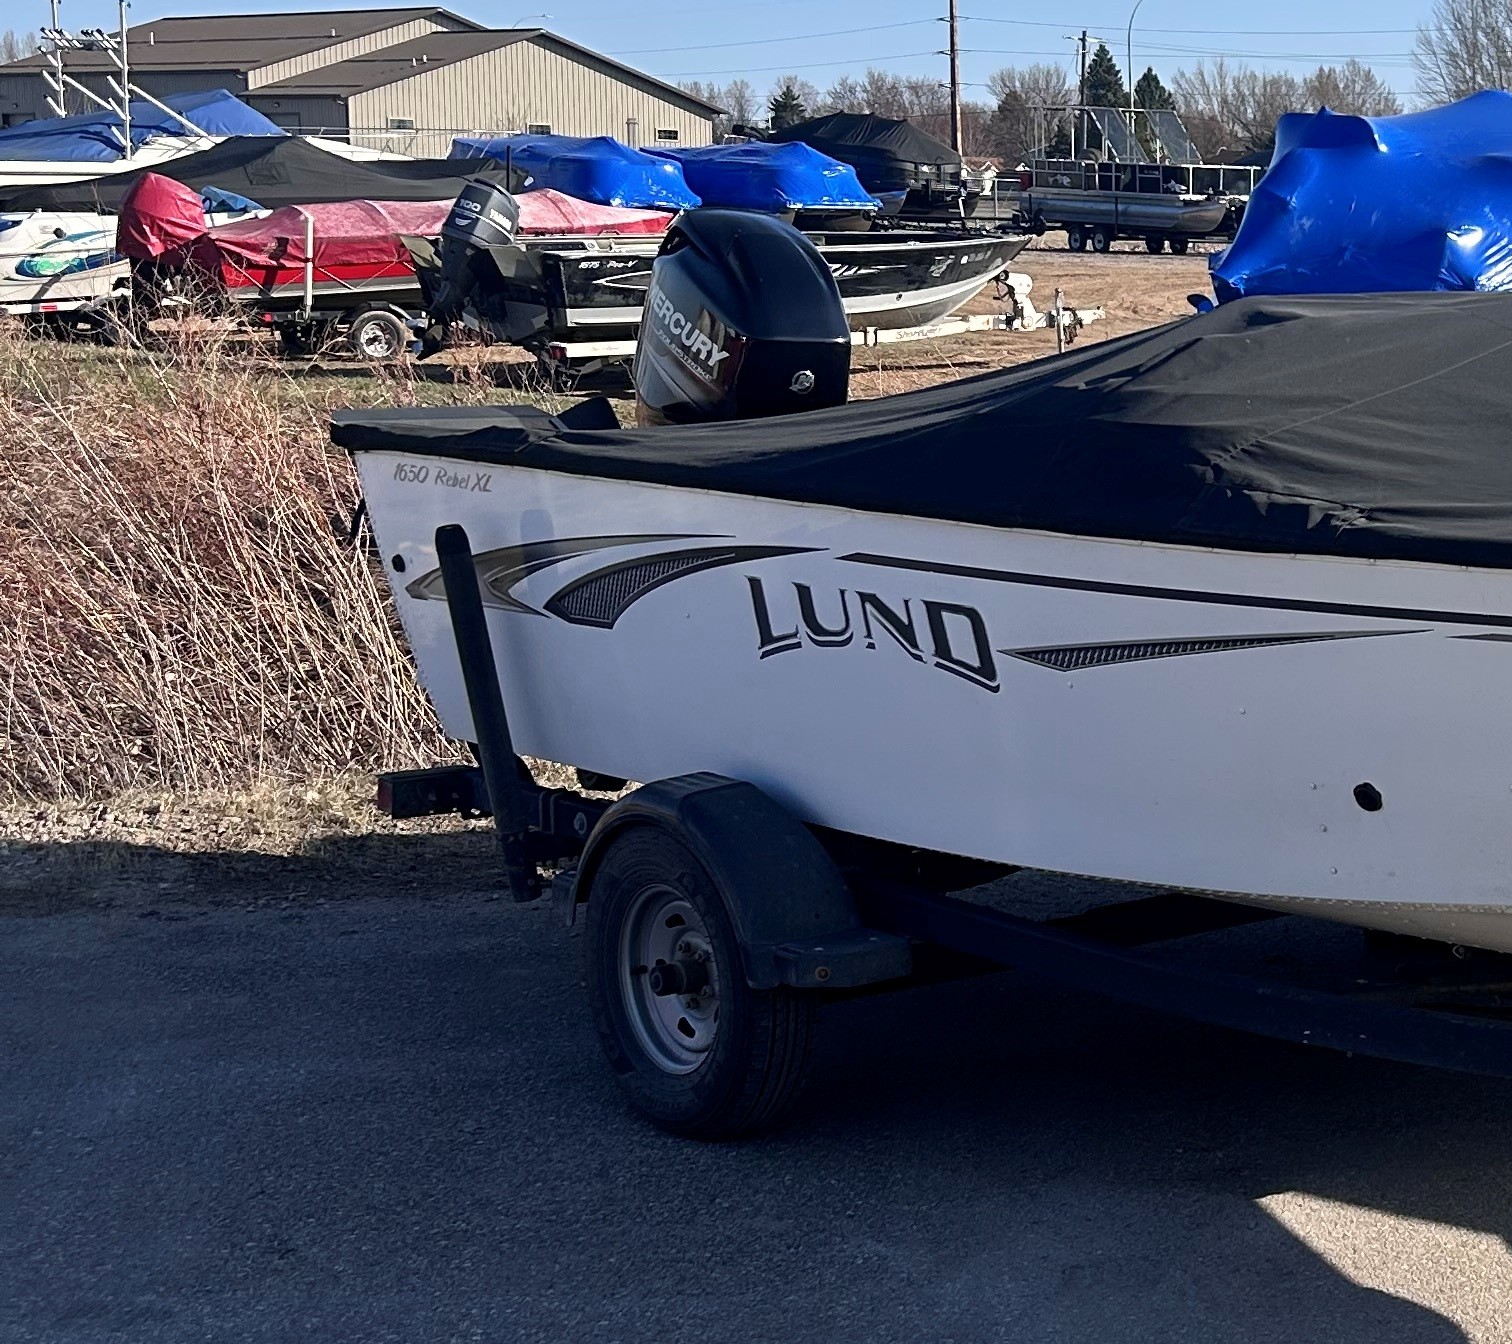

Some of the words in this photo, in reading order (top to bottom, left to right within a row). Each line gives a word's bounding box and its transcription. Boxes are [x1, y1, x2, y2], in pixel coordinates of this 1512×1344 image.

[393, 463, 430, 484] 1650
[435, 466, 470, 490] Rebel
[471, 472, 492, 493] XL
[744, 575, 1000, 693] LUND
